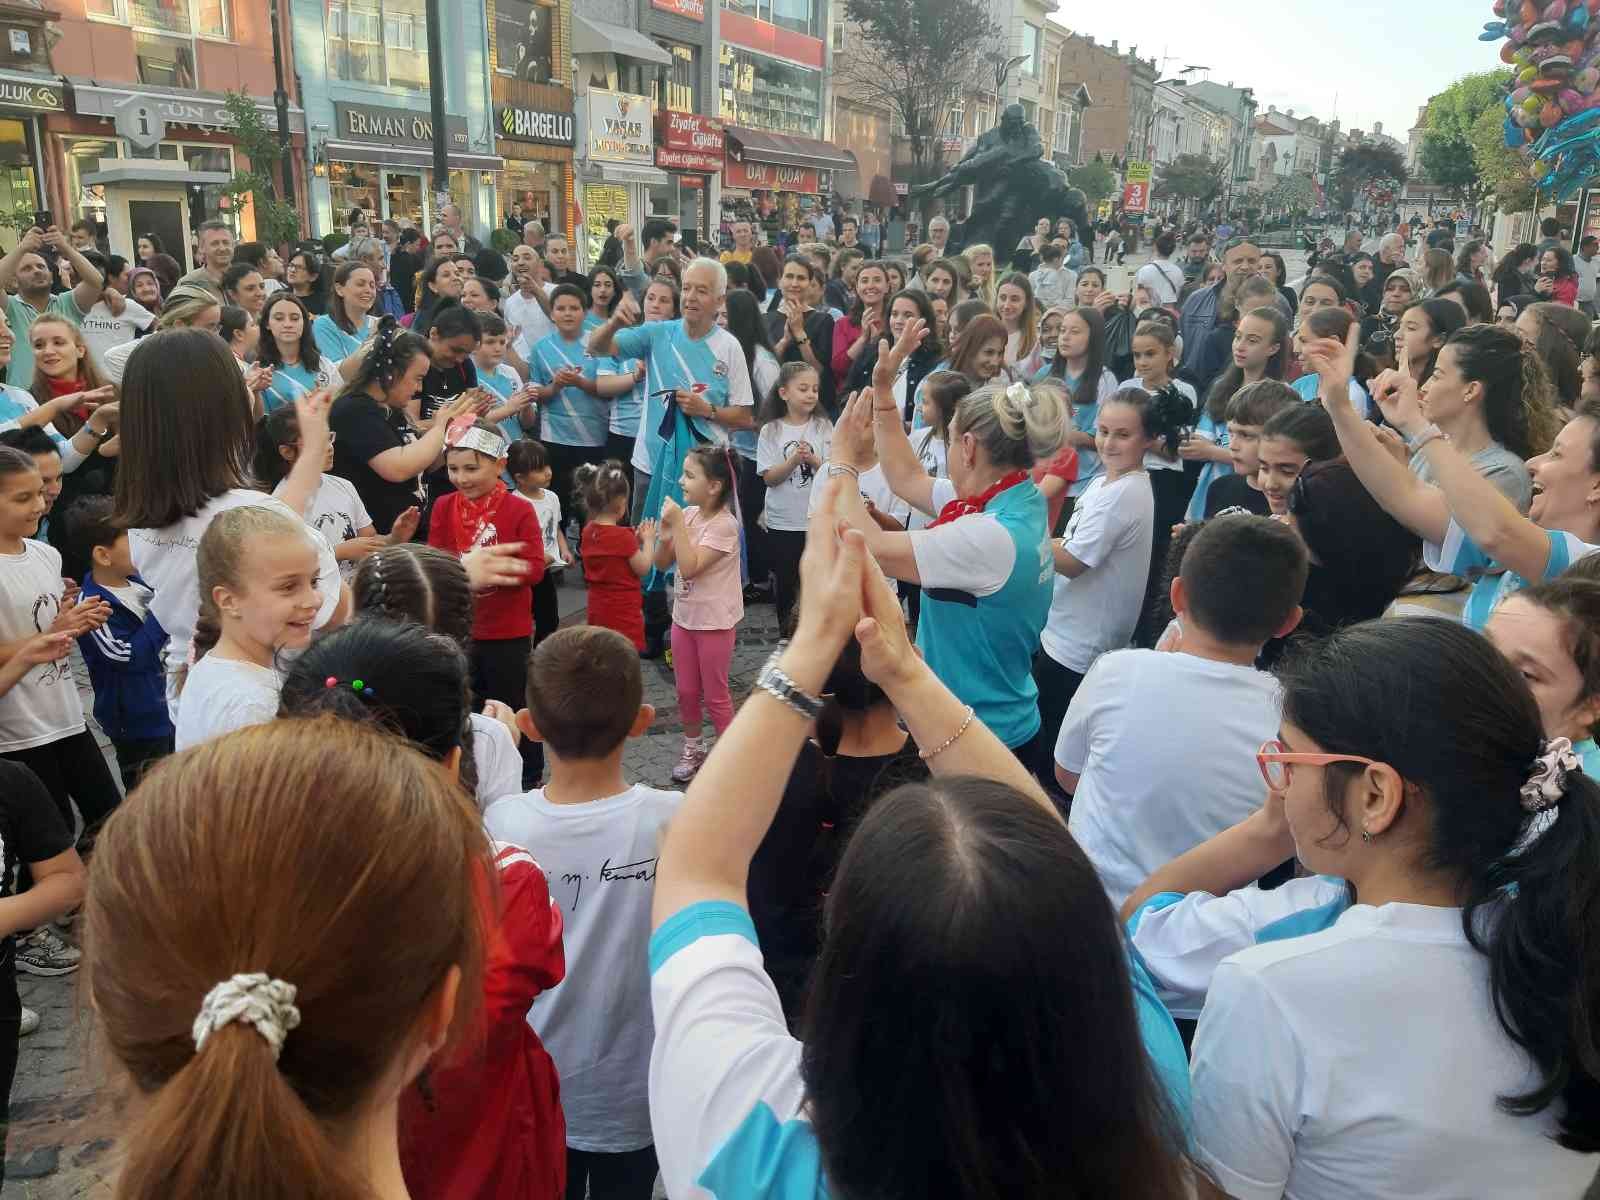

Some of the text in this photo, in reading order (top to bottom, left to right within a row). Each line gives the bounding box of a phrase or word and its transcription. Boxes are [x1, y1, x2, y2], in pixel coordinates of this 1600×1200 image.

[348, 110, 433, 141] ERMAN ÖN
[515, 109, 571, 140] BARGELLO
